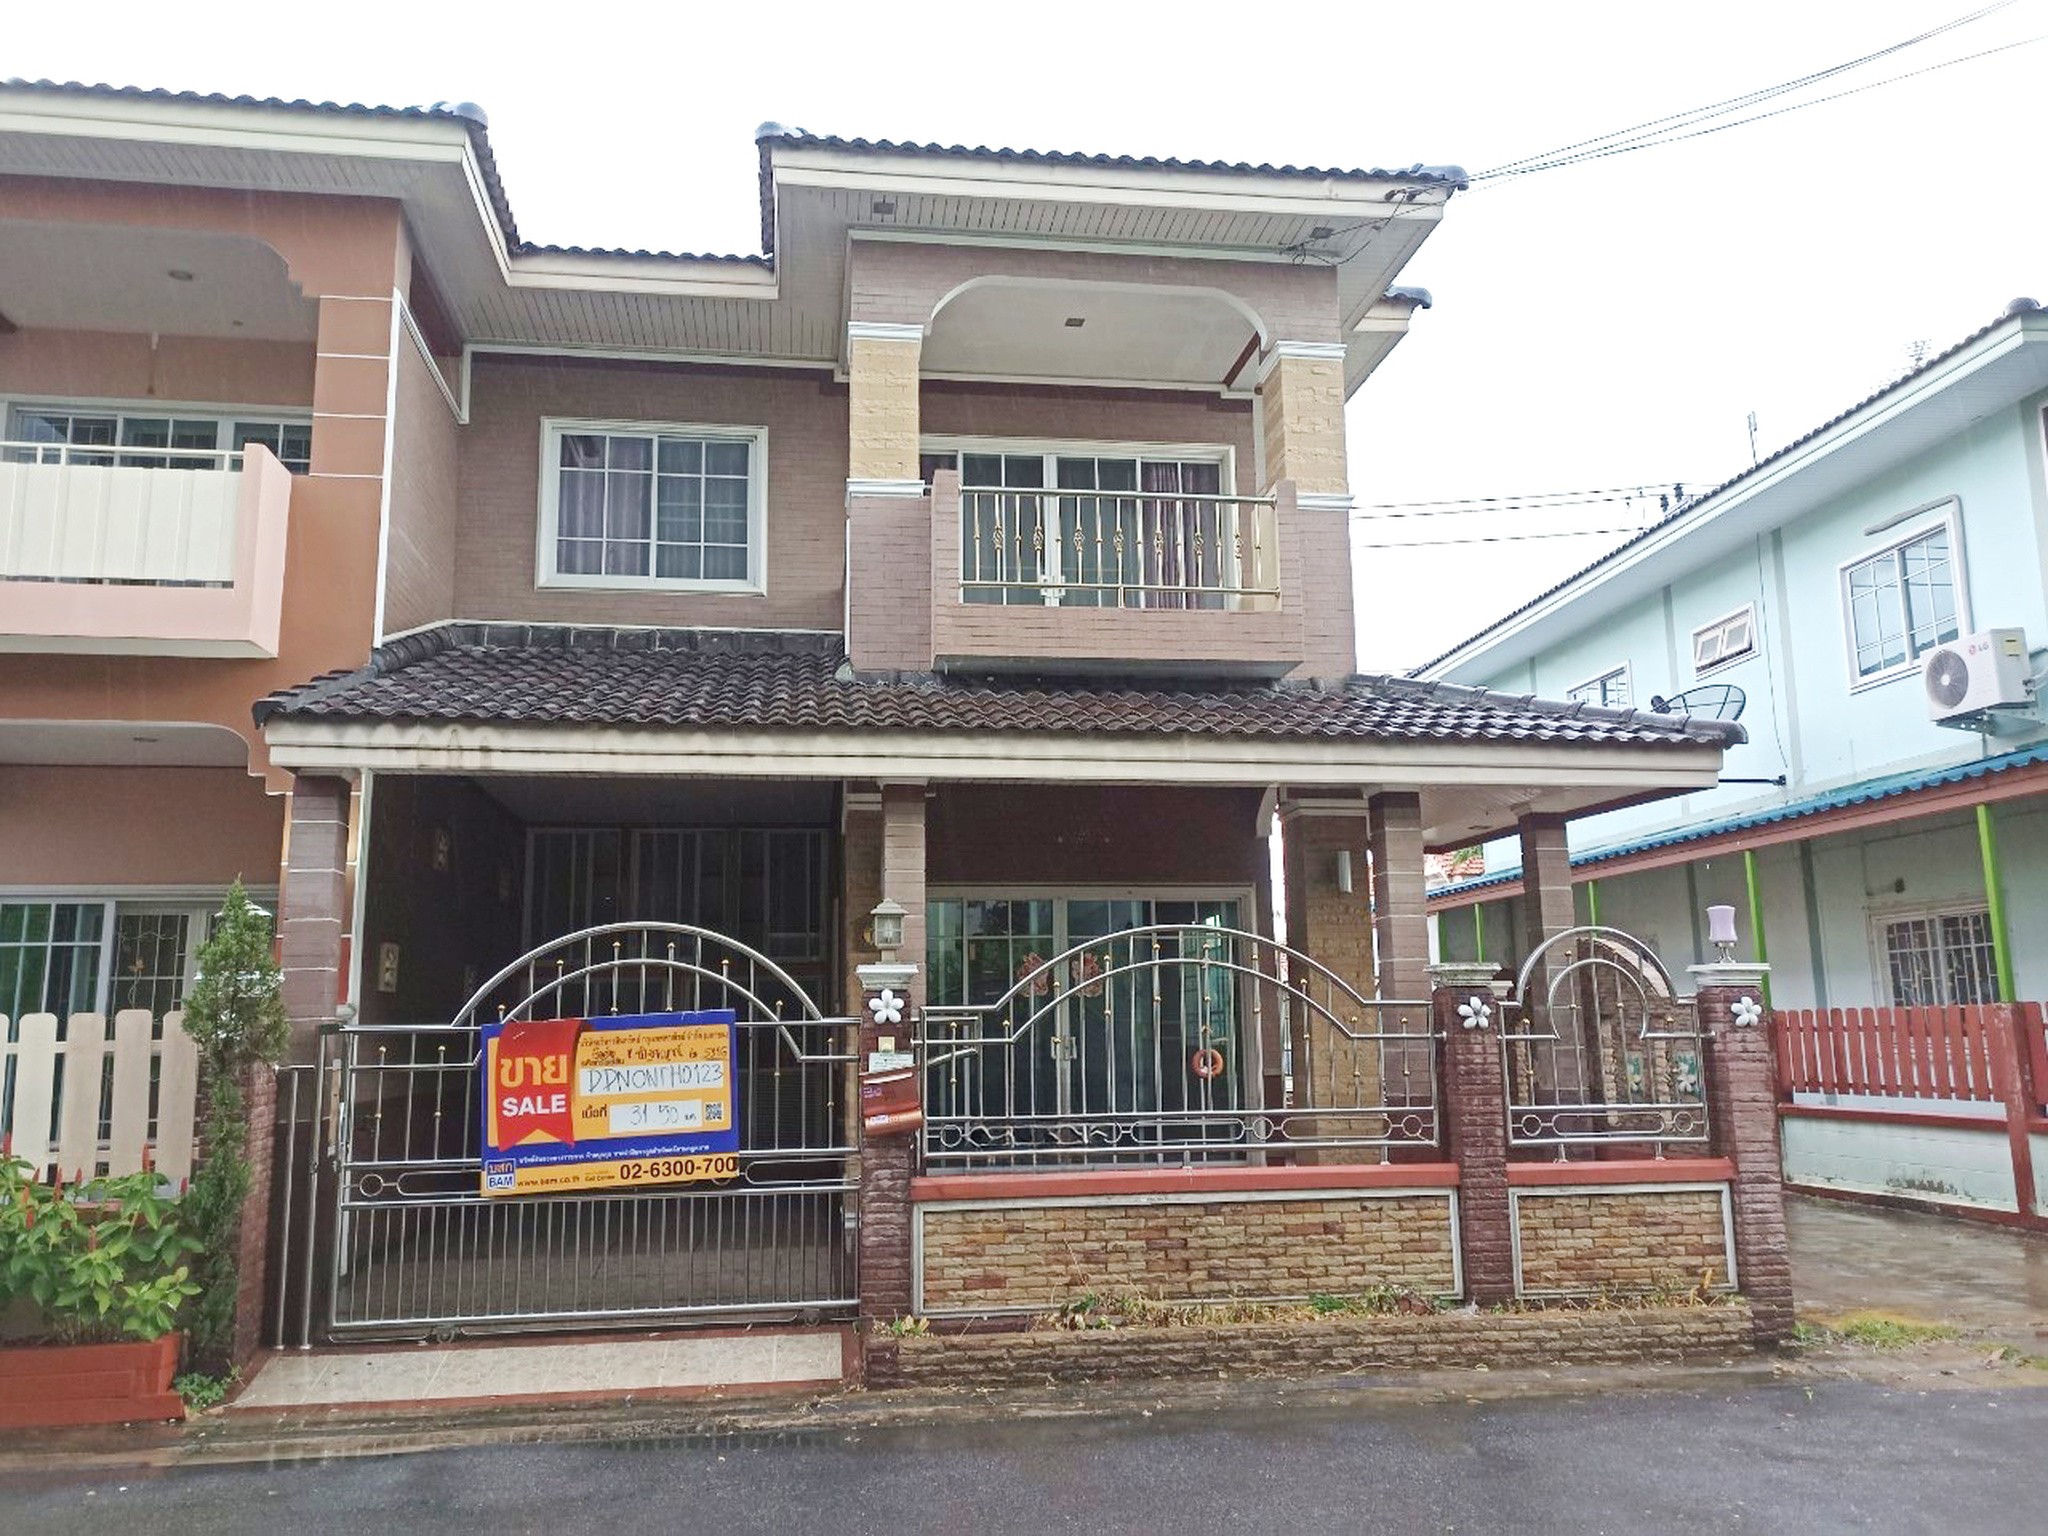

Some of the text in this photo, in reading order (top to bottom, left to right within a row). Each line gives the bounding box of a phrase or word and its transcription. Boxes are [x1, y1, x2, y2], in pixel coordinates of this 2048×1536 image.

[1978, 642, 1989, 651] LG
[501, 1055, 568, 1087] ขาย
[502, 1094, 567, 1117] SALE
[620, 1156, 738, 1180] 02-6300-700
[489, 1176, 513, 1188] BAM
